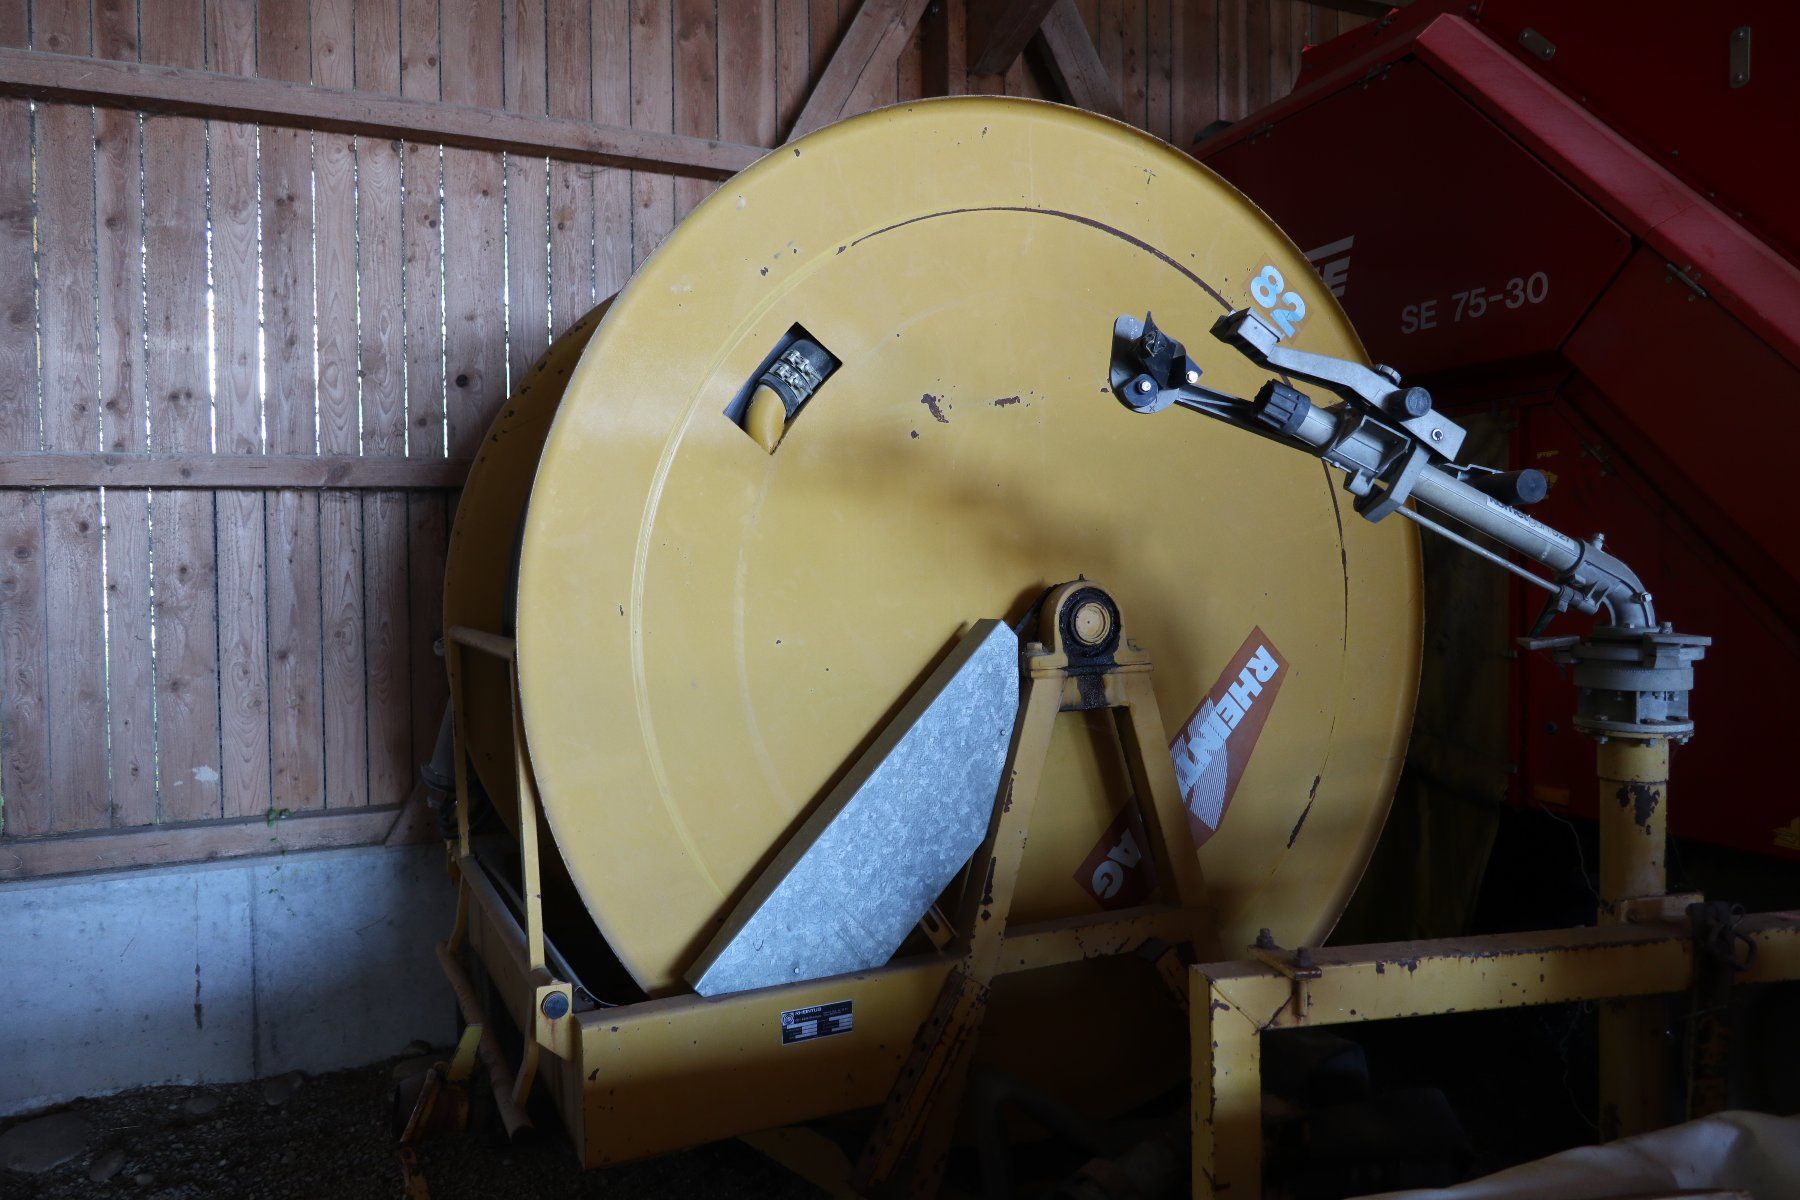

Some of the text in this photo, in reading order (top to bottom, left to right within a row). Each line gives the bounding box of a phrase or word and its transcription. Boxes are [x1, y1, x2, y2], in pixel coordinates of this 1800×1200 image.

[1251, 265, 1306, 337] 82
[1400, 271, 1549, 335] SE 75-30
[1091, 827, 1142, 900] AG
